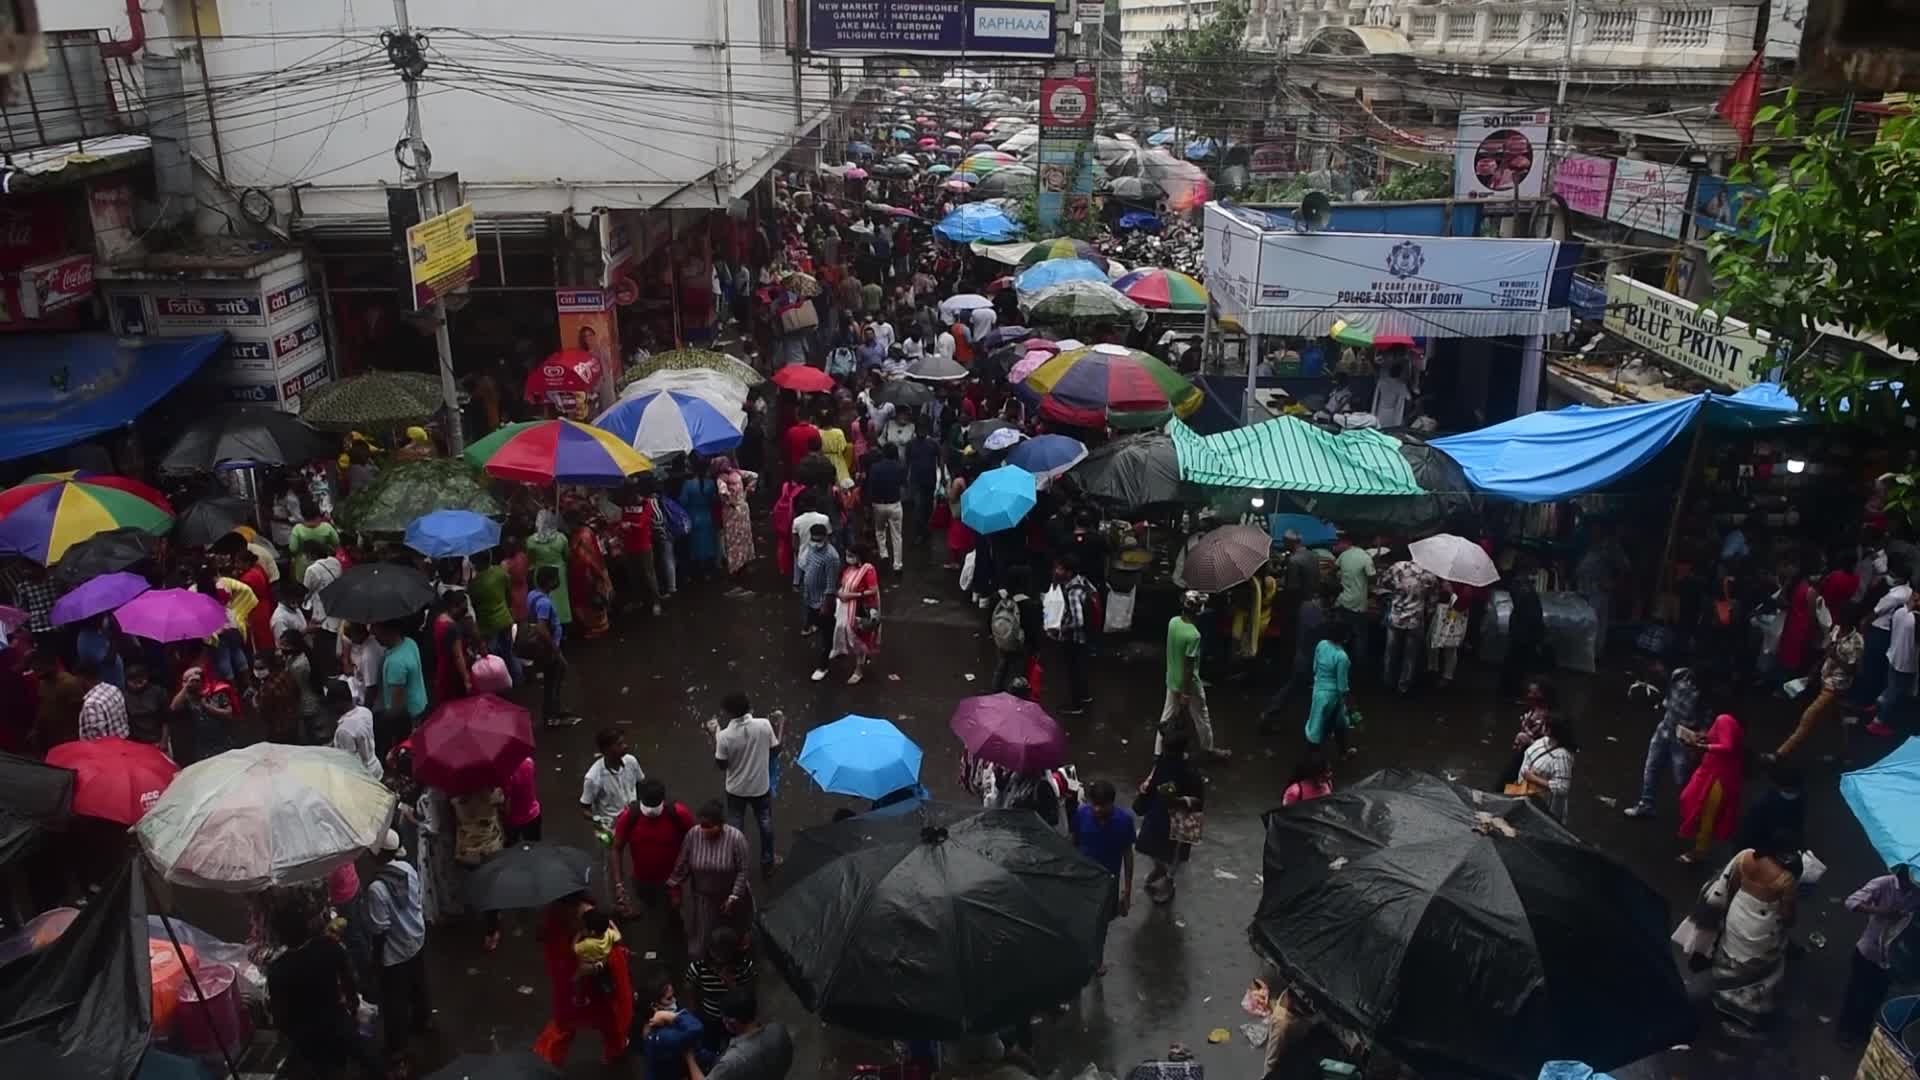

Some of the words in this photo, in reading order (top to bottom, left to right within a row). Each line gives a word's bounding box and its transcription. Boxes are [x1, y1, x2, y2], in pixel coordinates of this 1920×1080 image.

[818, 2, 838, 11] NEW
[842, 3, 879, 11] MARKET
[890, 3, 959, 13] CHOWRINGHEE
[832, 11, 880, 20] GARIAHAT
[891, 12, 945, 21] HATIBAGAN
[835, 21, 860, 30] LAKE
[862, 21, 888, 30] MALL
[895, 22, 942, 31] BURDWAN
[836, 31, 877, 40] SILIGURI
[879, 31, 901, 40] CITY
[903, 32, 940, 41] CENTRE
[1385, 281, 1405, 291] CARE
[1337, 291, 1373, 304] POLICE
[1374, 292, 1428, 305] ASSISTANT
[1430, 292, 1464, 305] BOOTH
[1647, 296, 1672, 315] NEW
[1675, 308, 1726, 336] MARKET
[1625, 303, 1673, 343] BLUE
[1678, 324, 1743, 372] PRINT
[1633, 331, 1669, 354] CHEMISTS
[1677, 352, 1724, 380] DRUGGISTS
